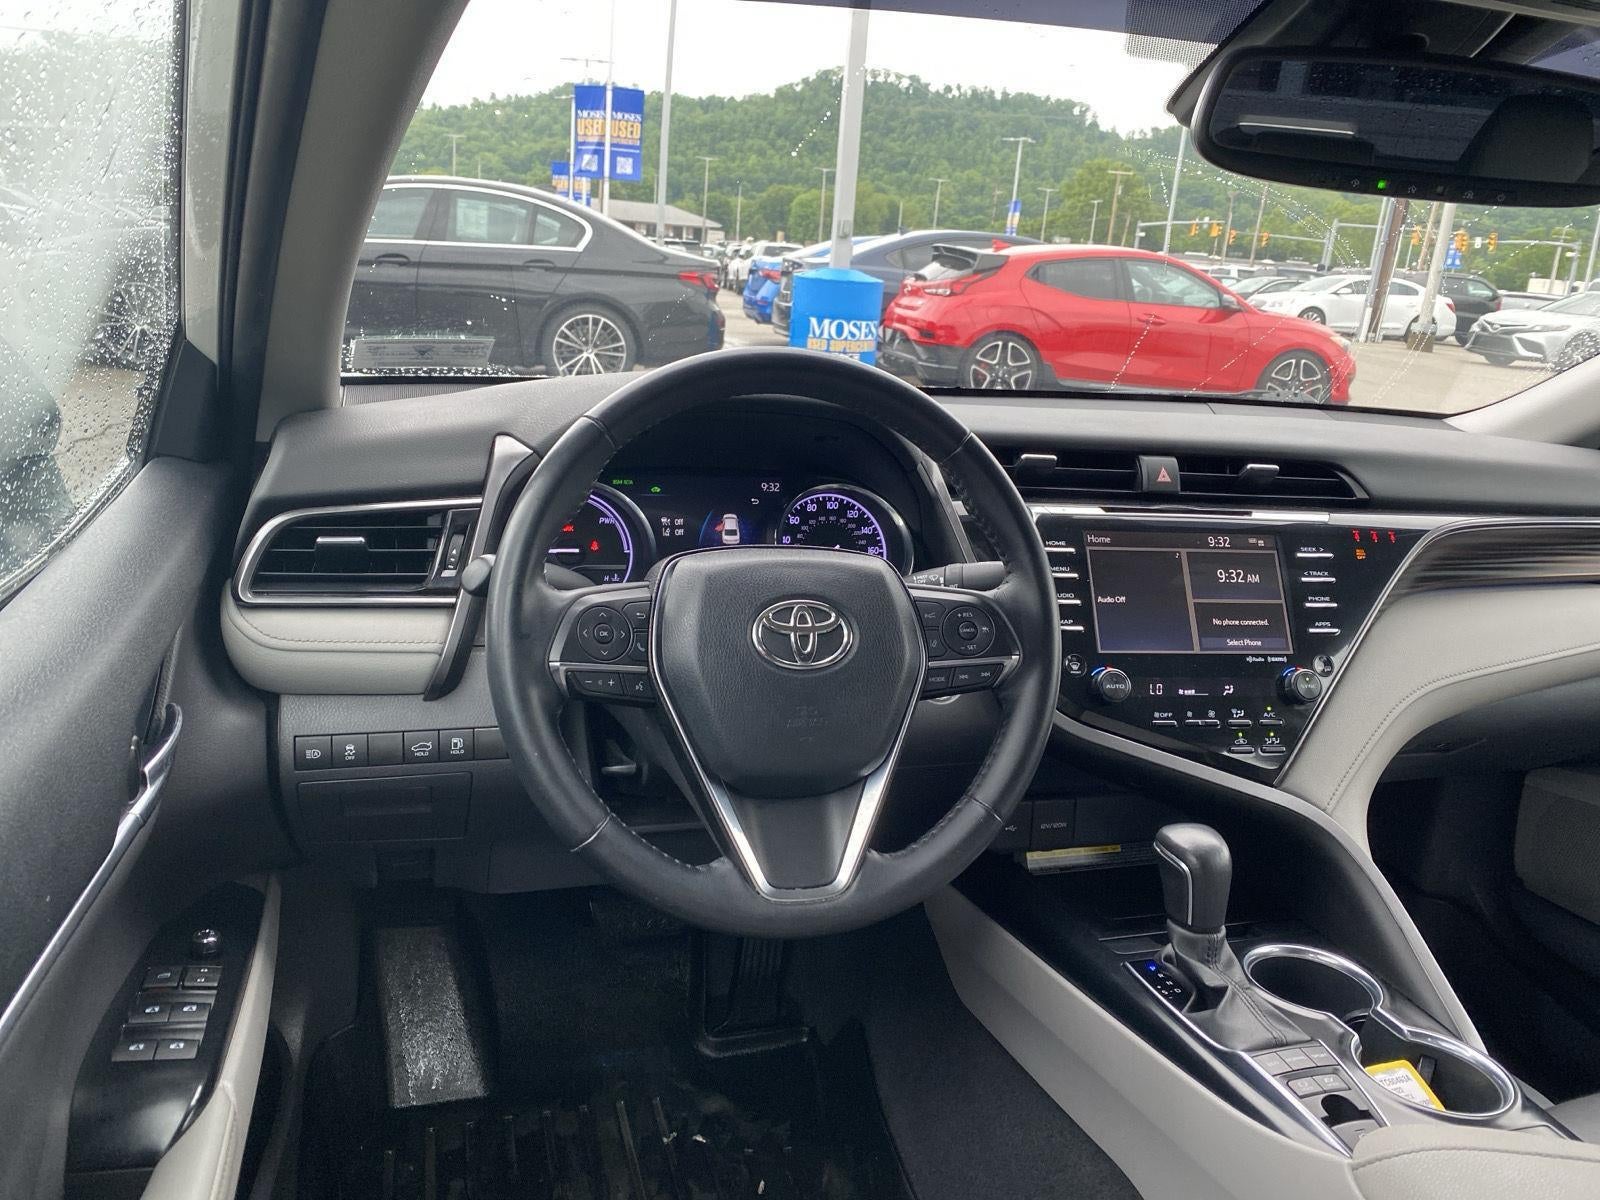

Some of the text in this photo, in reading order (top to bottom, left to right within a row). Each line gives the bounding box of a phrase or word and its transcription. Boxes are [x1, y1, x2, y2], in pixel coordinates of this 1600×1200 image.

[612, 111, 642, 121] MOSES
[611, 121, 641, 138] USED
[808, 316, 877, 341] MOSES
[761, 482, 780, 492] 9:32
[807, 504, 817, 512] 80
[826, 502, 838, 510] 100
[846, 510, 858, 518] 120
[674, 518, 684, 526] Off
[789, 516, 800, 524] 60
[861, 526, 872, 535] 140
[1087, 534, 1111, 544] Home
[1207, 536, 1231, 548] 9:32
[868, 547, 880, 555] 160
[1216, 569, 1260, 583] 9:32 AM
[1222, 618, 1240, 626] phone
[1226, 638, 1244, 646] Select
